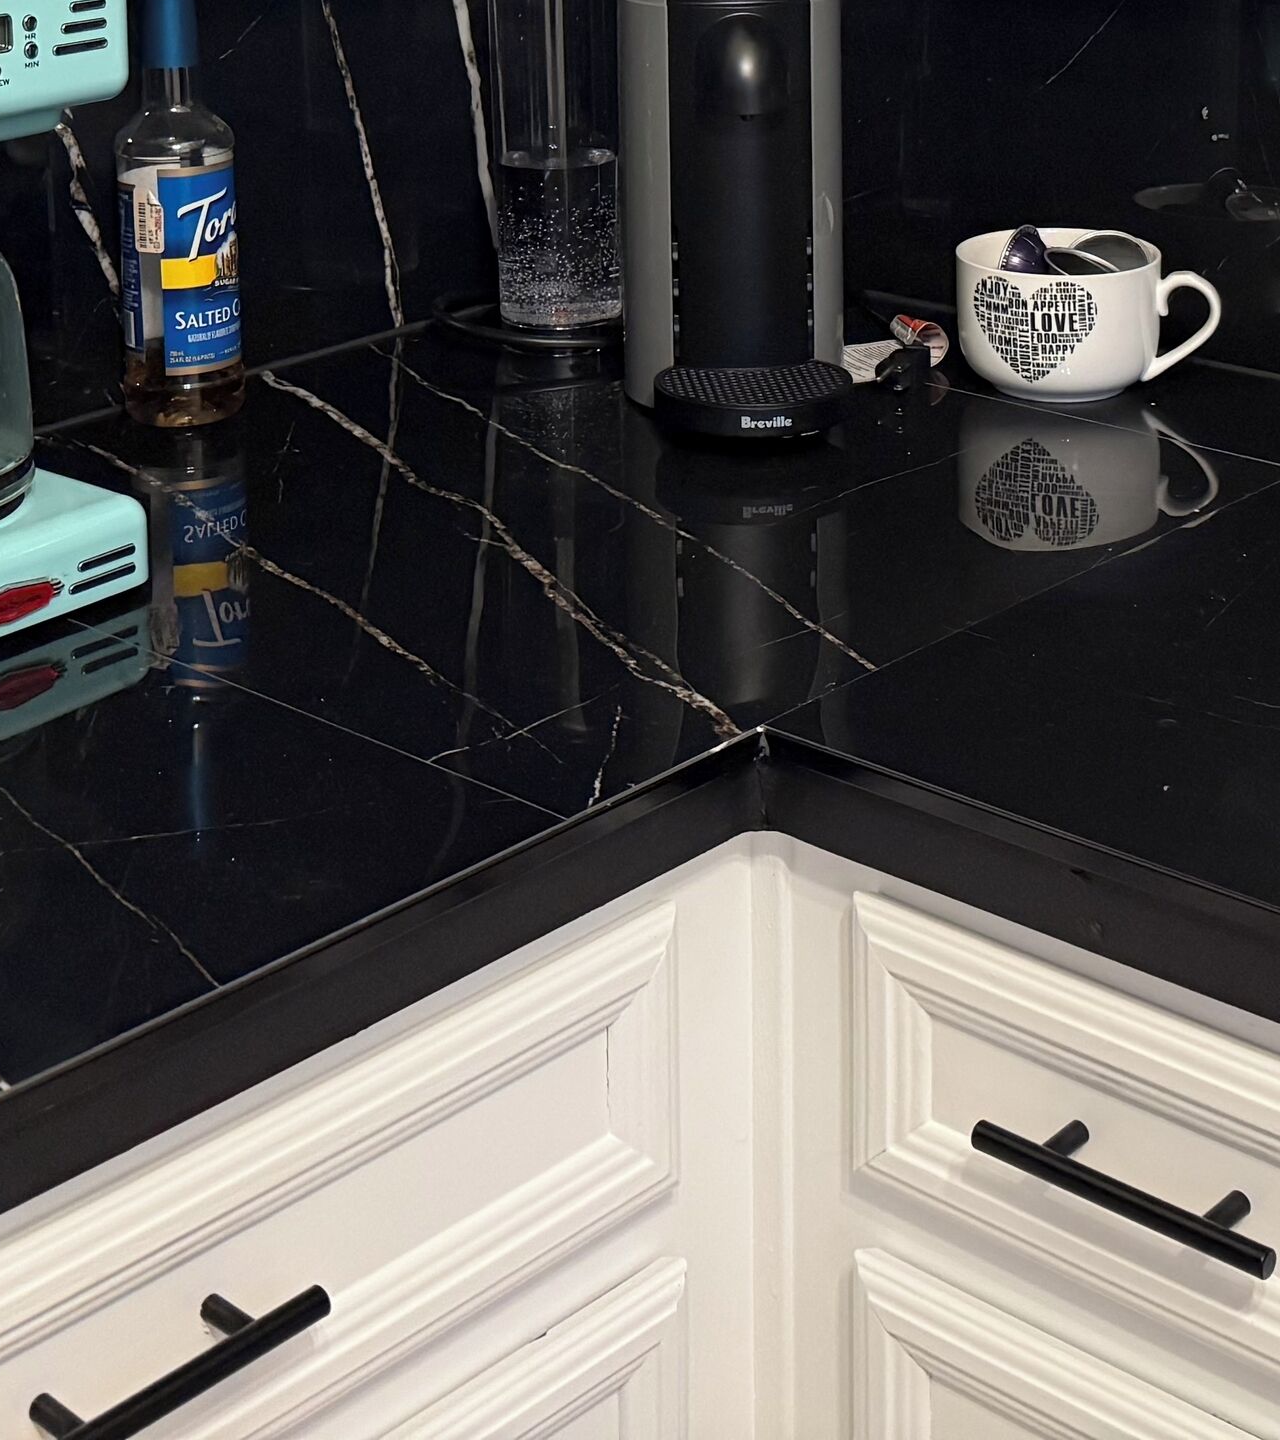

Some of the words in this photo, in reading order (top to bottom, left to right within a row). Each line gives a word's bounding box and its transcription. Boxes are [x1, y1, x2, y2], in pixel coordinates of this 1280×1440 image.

[24, 60, 40, 69] MIN
[1009, 298, 1028, 311] BON
[1032, 301, 1077, 312] APPETIT
[175, 306, 231, 330] SALTED
[994, 314, 1029, 327] DELICIOUS
[1030, 312, 1077, 332] LOVE
[1031, 332, 1058, 344] FOOD
[1019, 326, 1033, 380] EXQUISITE
[1041, 344, 1076, 355] HAPPY
[740, 415, 793, 429] Breville
